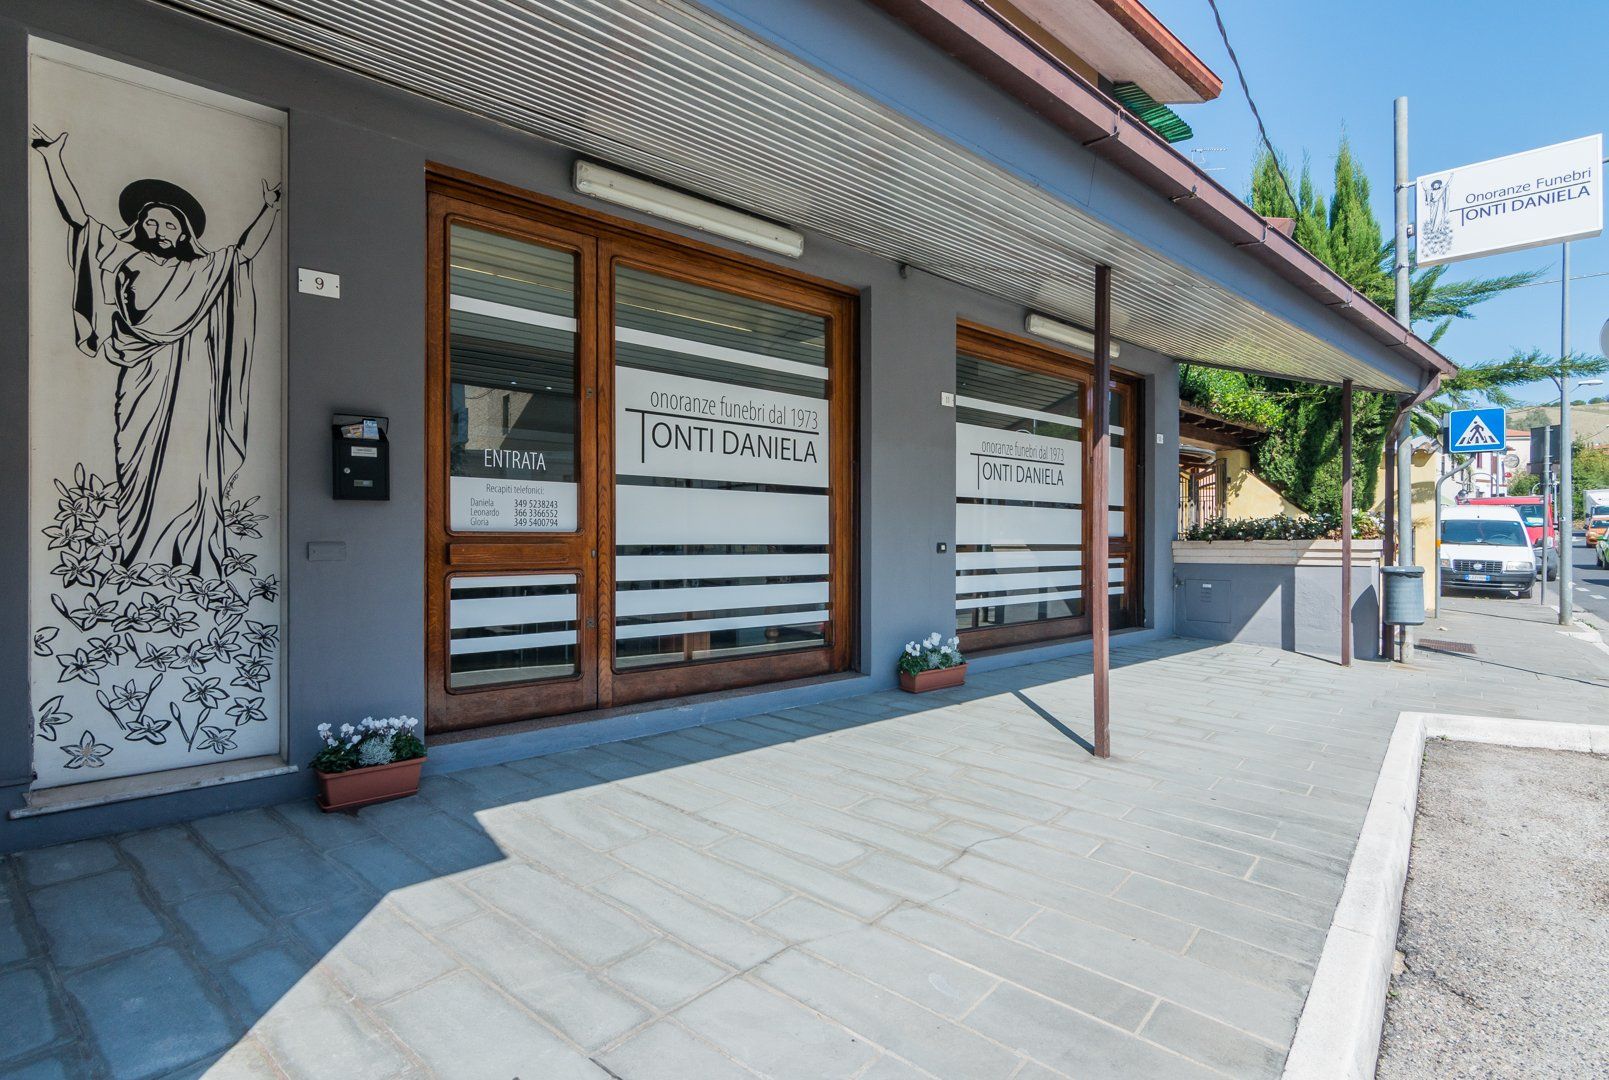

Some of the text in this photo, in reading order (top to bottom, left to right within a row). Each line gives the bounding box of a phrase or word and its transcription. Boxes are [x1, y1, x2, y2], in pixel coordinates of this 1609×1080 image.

[1465, 167, 1591, 204] Onoranze Funebri
[1457, 185, 1590, 226] TONTI DANIELA
[315, 277, 324, 290] 9
[650, 391, 818, 430] onoranze funebri dal 1973
[632, 408, 818, 463] TONTI DANIELA
[484, 448, 546, 471] ENTRATA
[981, 441, 1065, 462] onoranze funebri dal 1973
[974, 453, 1064, 490] TONTI DANIELA
[486, 483, 545, 495] Recapiti telefonici:
[470, 498, 558, 509] Daniela 349 5238243
[470, 508, 558, 518] Leonardo 366 3366552
[470, 517, 558, 527] Gloria 349 5400794
